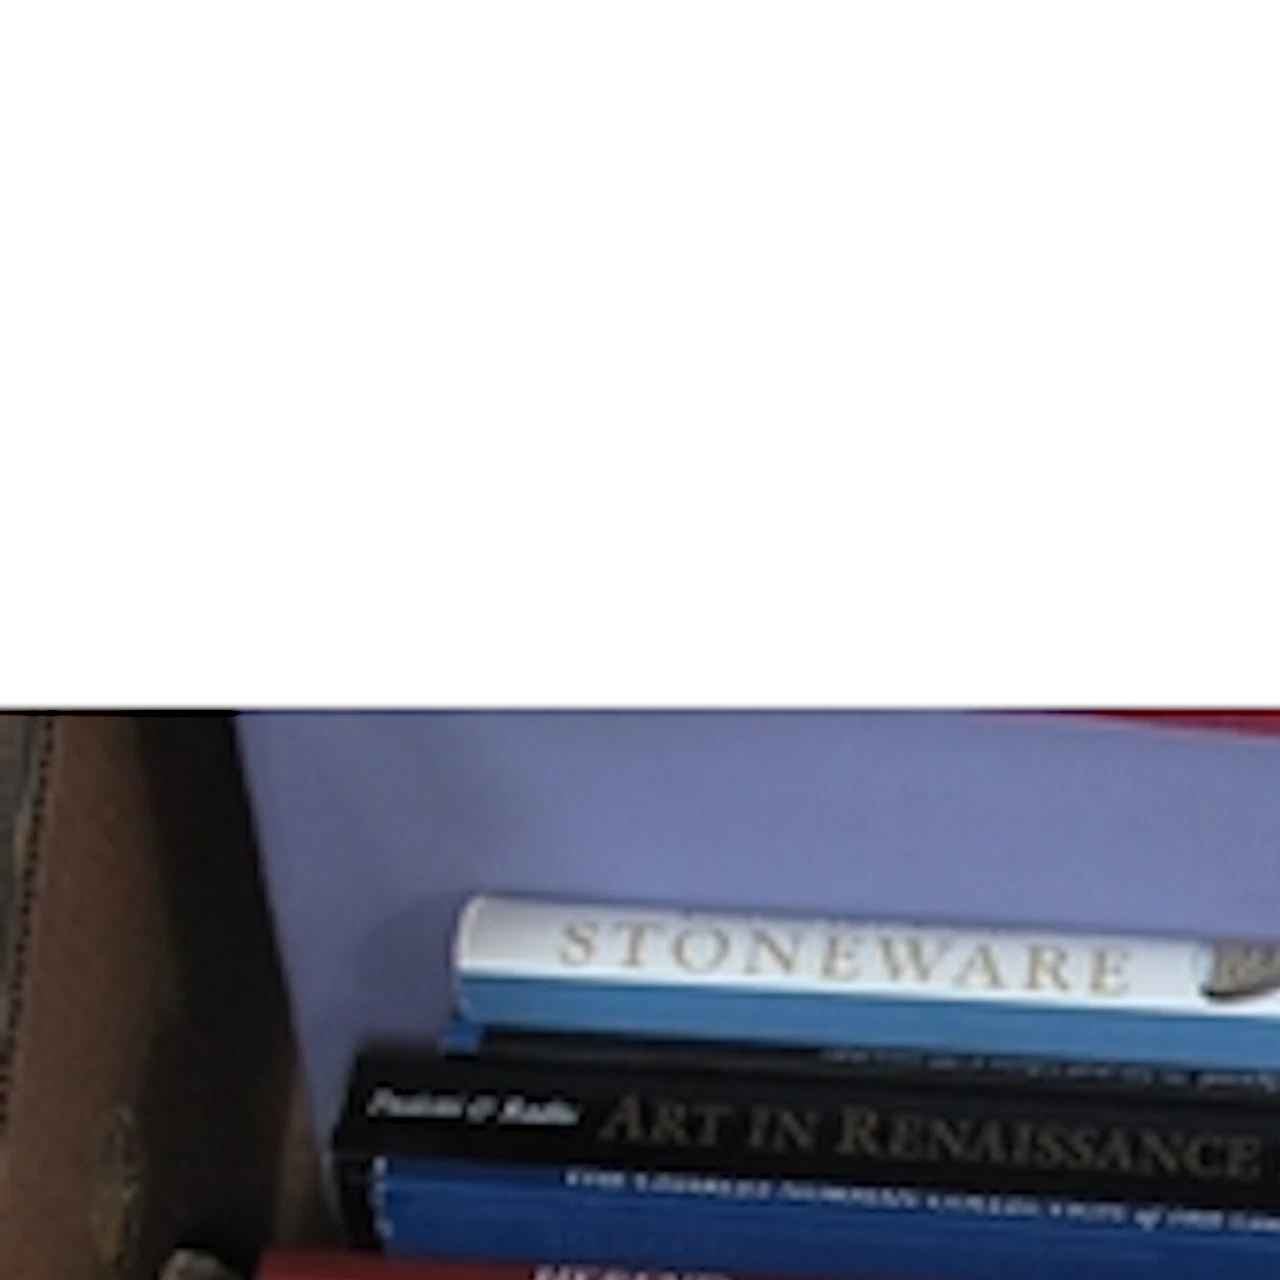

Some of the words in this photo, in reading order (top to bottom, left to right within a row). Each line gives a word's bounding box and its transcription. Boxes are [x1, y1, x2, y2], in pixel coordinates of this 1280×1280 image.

[557, 920, 1132, 996] STONEWARE
[602, 1095, 730, 1150] ART
[746, 1104, 818, 1153] IN
[836, 1104, 1264, 1184] RENAISSANCE
